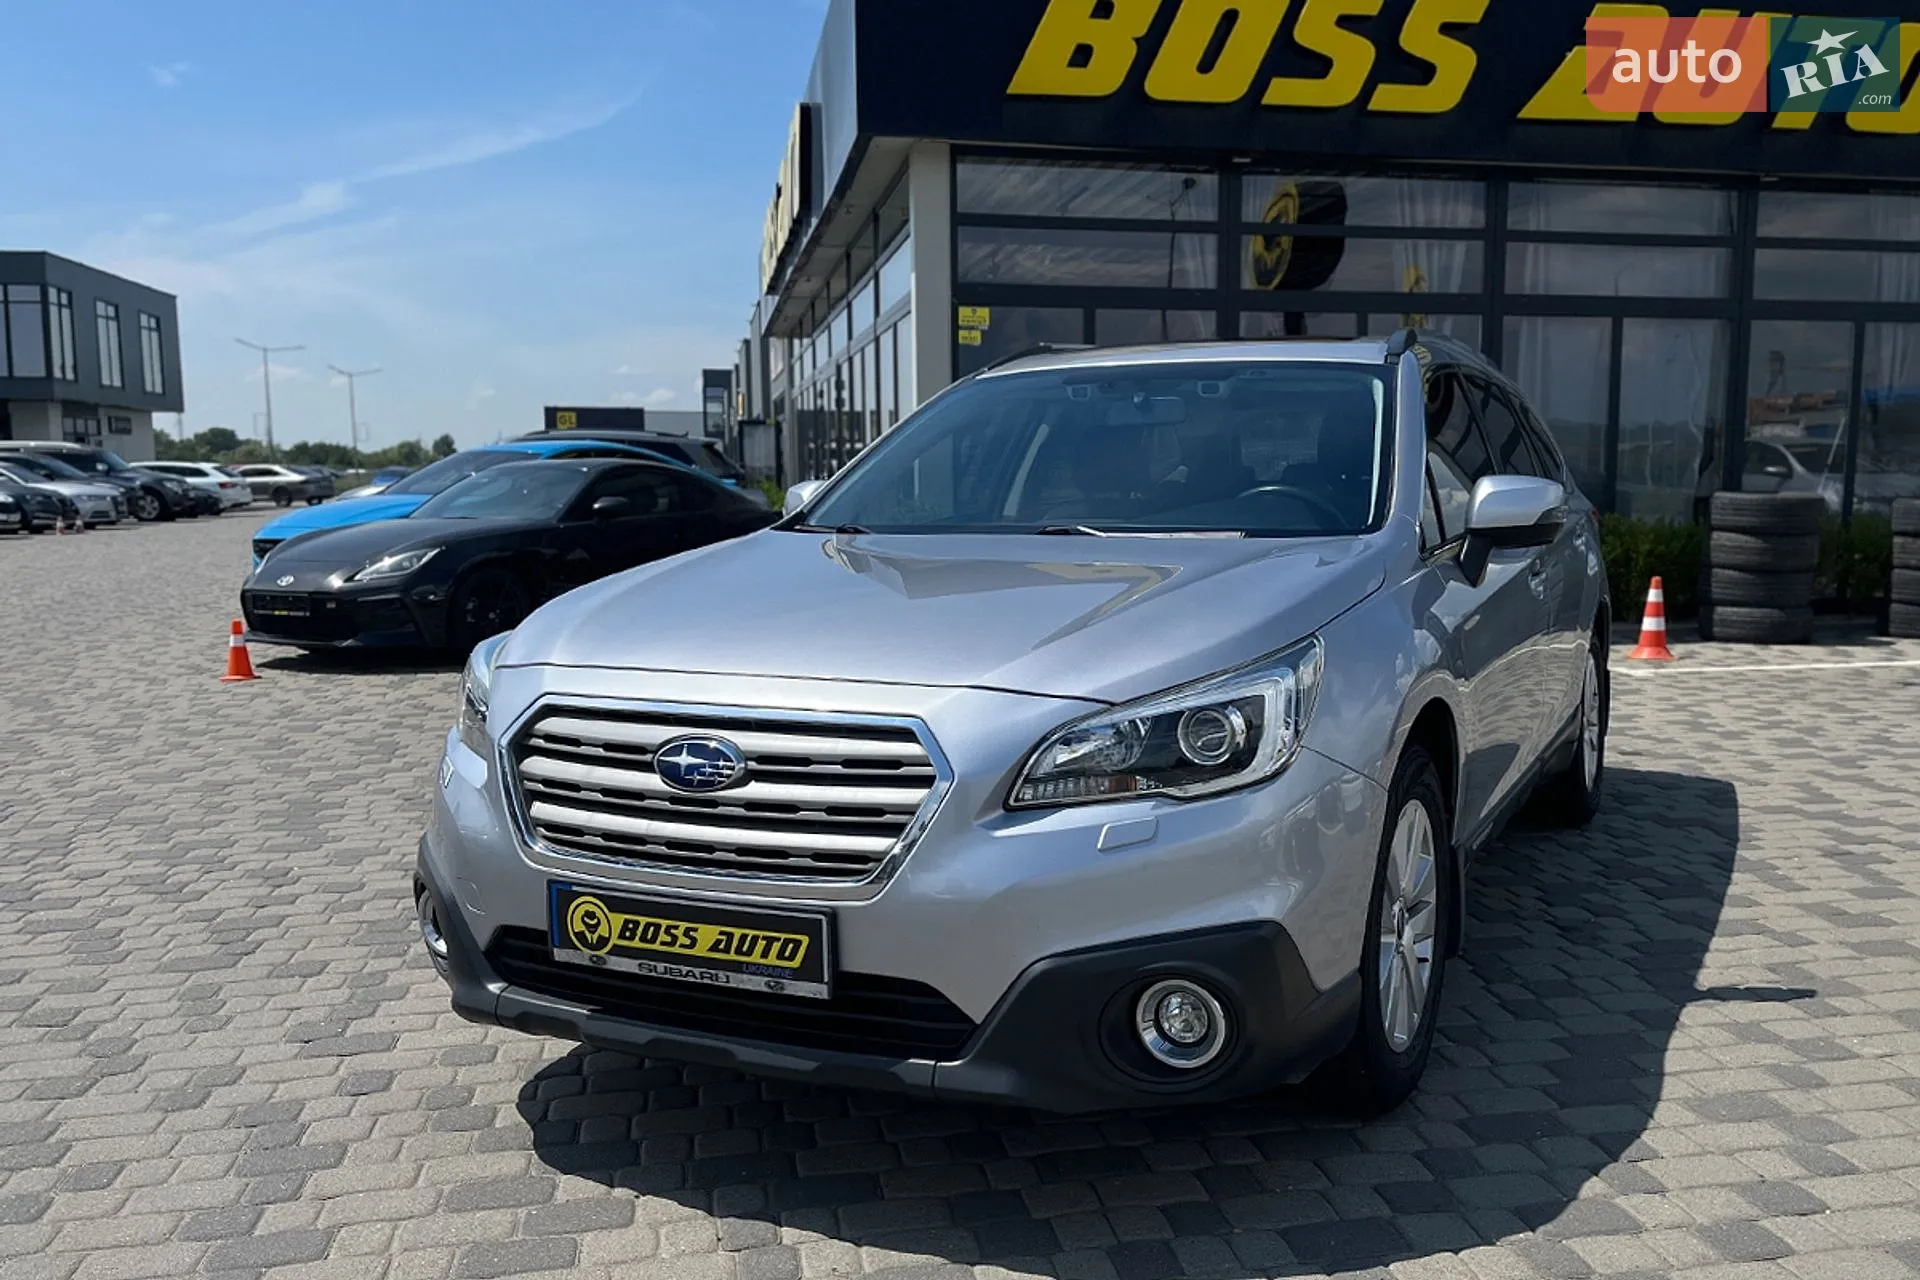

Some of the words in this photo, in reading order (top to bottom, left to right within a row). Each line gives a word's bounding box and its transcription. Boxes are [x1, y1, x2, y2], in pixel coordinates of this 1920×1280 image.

[1006, 0, 1491, 113] BOSS
[1517, 2, 1920, 134] AUTO
[617, 917, 699, 950] BOSS
[706, 930, 802, 963] AUTO
[637, 962, 731, 984] SUBARU
